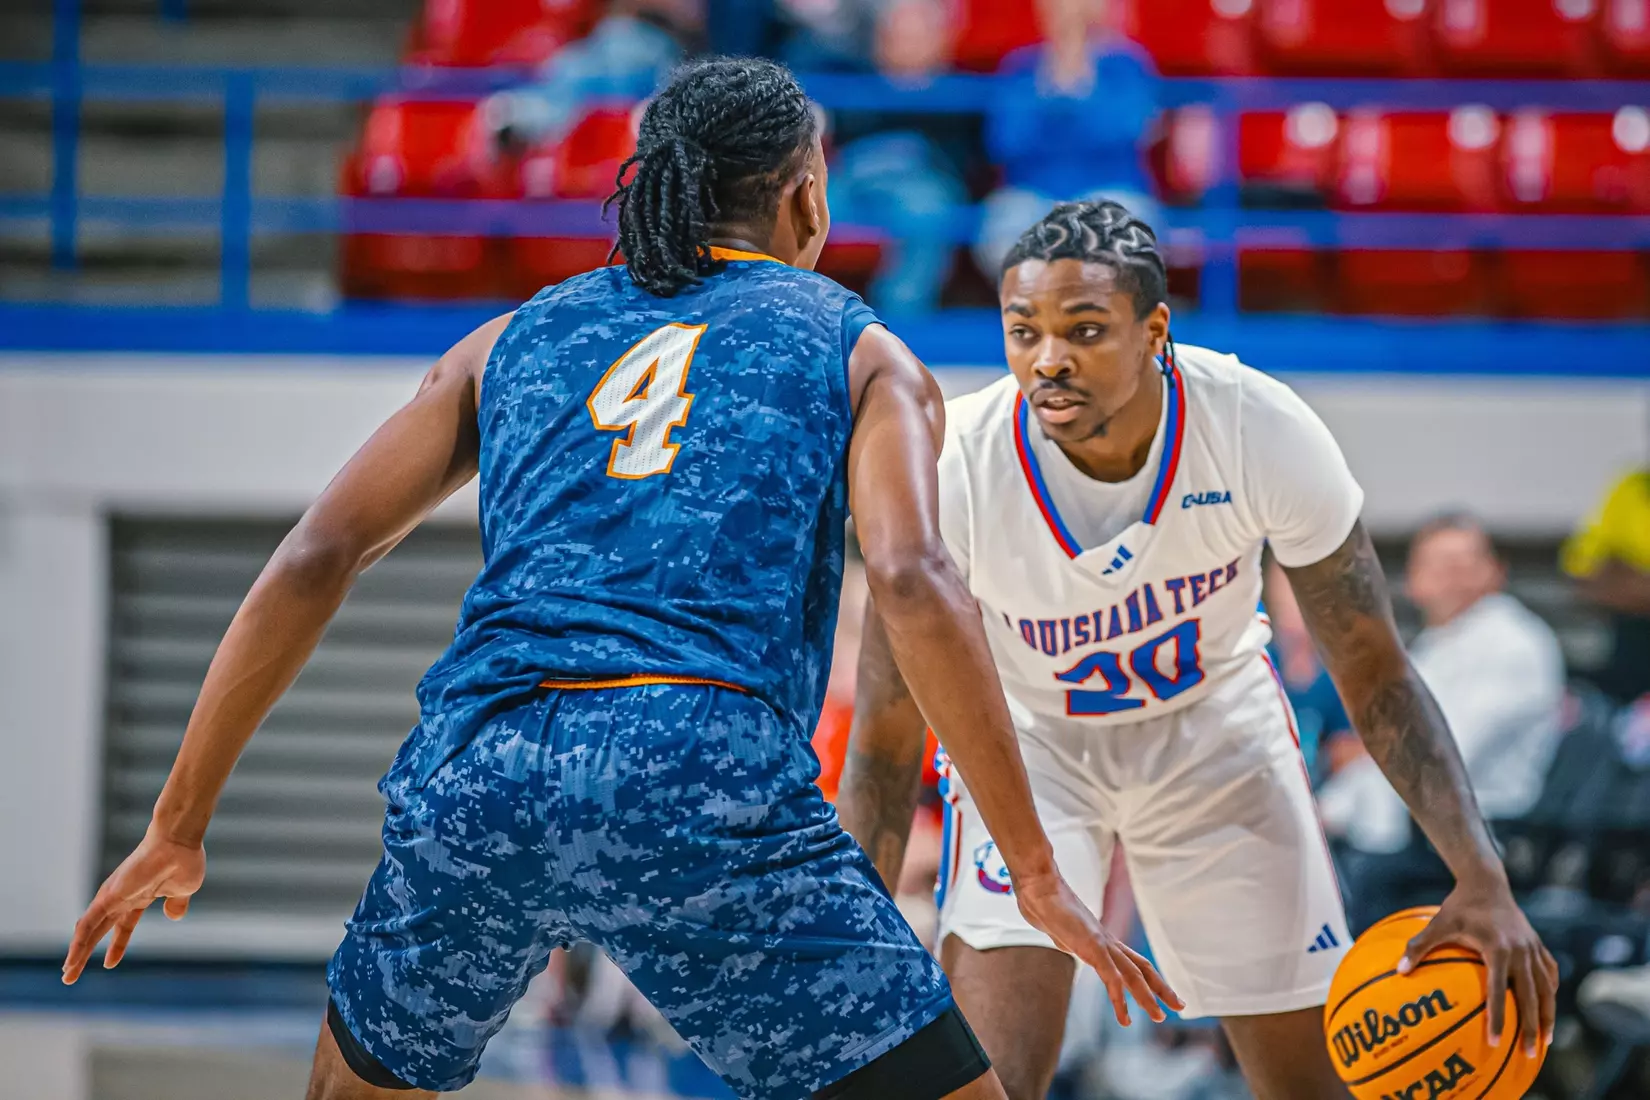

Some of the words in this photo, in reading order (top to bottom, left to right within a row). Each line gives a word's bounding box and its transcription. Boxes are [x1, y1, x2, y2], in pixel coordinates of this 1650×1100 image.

[586, 322, 708, 480] 4
[1002, 583, 1164, 658] OUISIANA
[1054, 617, 1205, 717] 20
[1332, 989, 1454, 1068] Wilson
